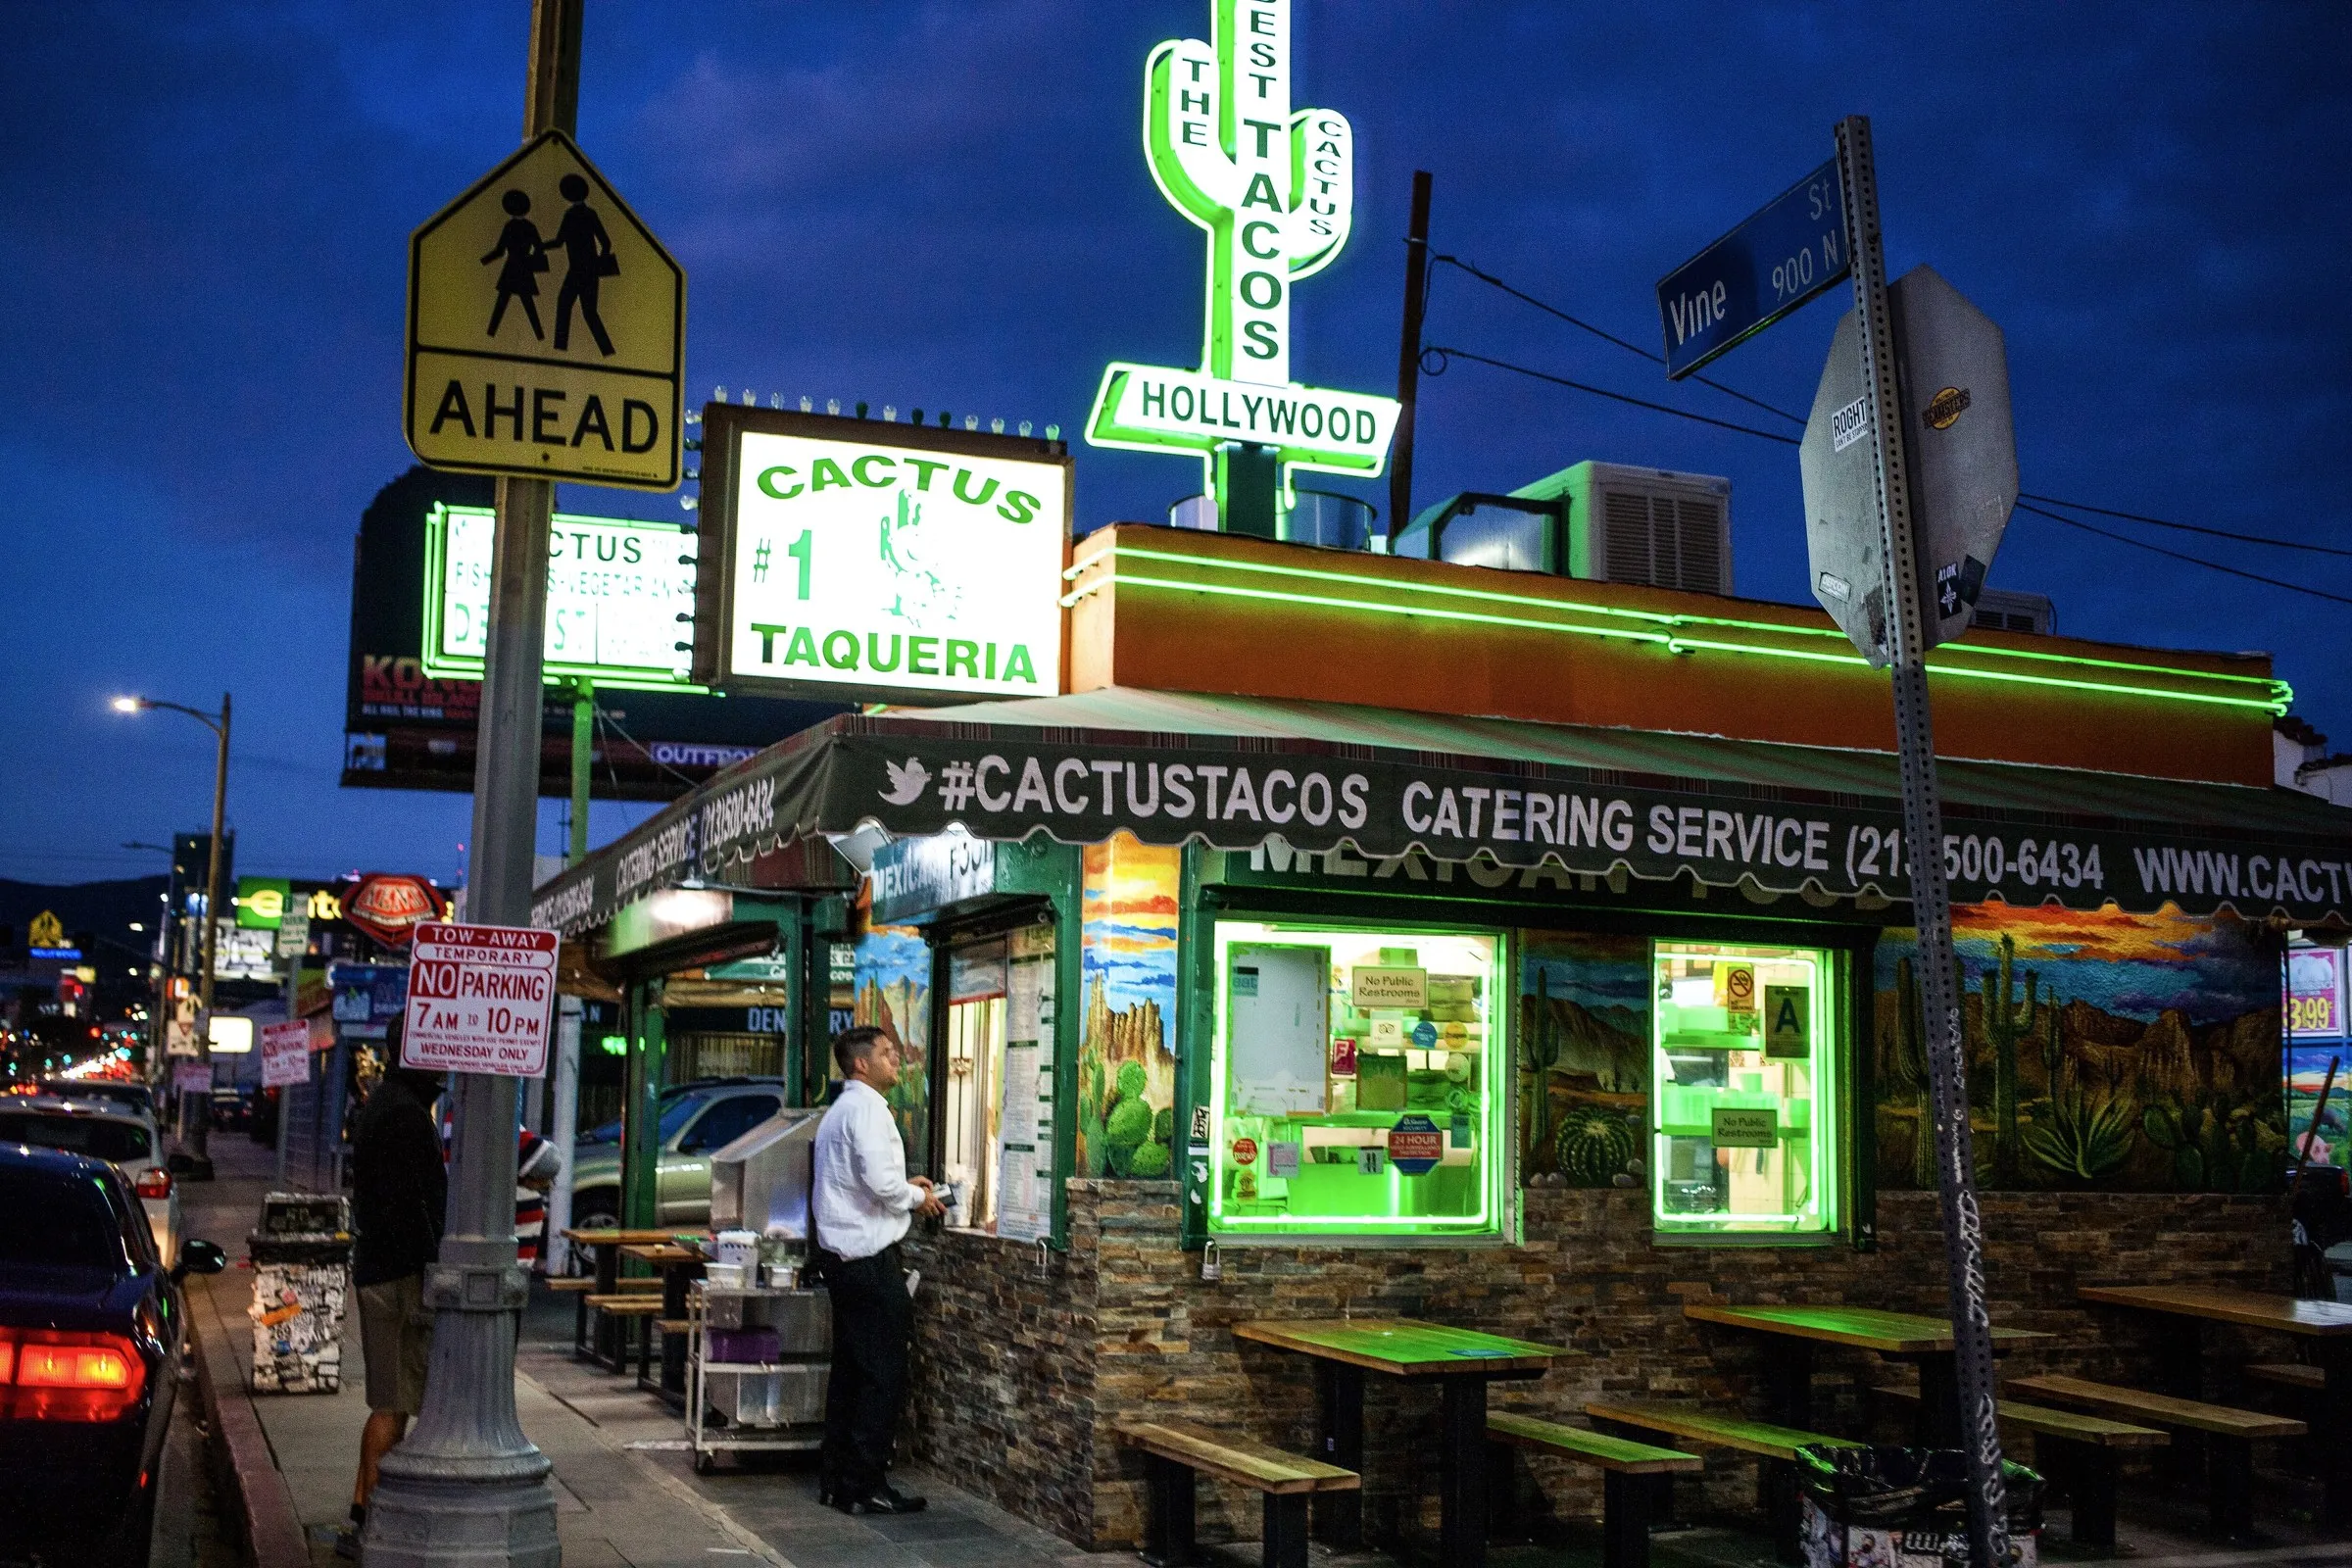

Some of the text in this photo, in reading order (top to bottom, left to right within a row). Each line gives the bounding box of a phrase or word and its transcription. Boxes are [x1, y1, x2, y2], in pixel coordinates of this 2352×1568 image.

[1180, 57, 1210, 147] THE
[1240, 0, 1283, 361] EST TACOS
[1308, 121, 1344, 237] CACTUS
[1809, 176, 1834, 222] St
[1669, 229, 1839, 347] Vine 900 N
[428, 379, 660, 455] AHEAD
[1142, 380, 1377, 446] HOLLYWOOD
[1833, 398, 1866, 438] ROGHT
[757, 454, 1042, 524] CACTUS
[750, 621, 1039, 684] TAQUERIA
[656, 744, 757, 767] OUTFRO
[938, 754, 1369, 830] #CACTUSTACOS
[1401, 780, 1634, 853] CATERING
[1646, 804, 1830, 871] SERVICE
[416, 961, 545, 1003] NO PARKING
[434, 947, 535, 965] TEMPORARY
[1365, 975, 1413, 987] No Public
[1358, 986, 1420, 998] Restrooms
[1774, 997, 1801, 1034] A
[420, 1042, 529, 1061] WEDNESDAY ONLY
[1406, 1136, 1438, 1145] HOUR
